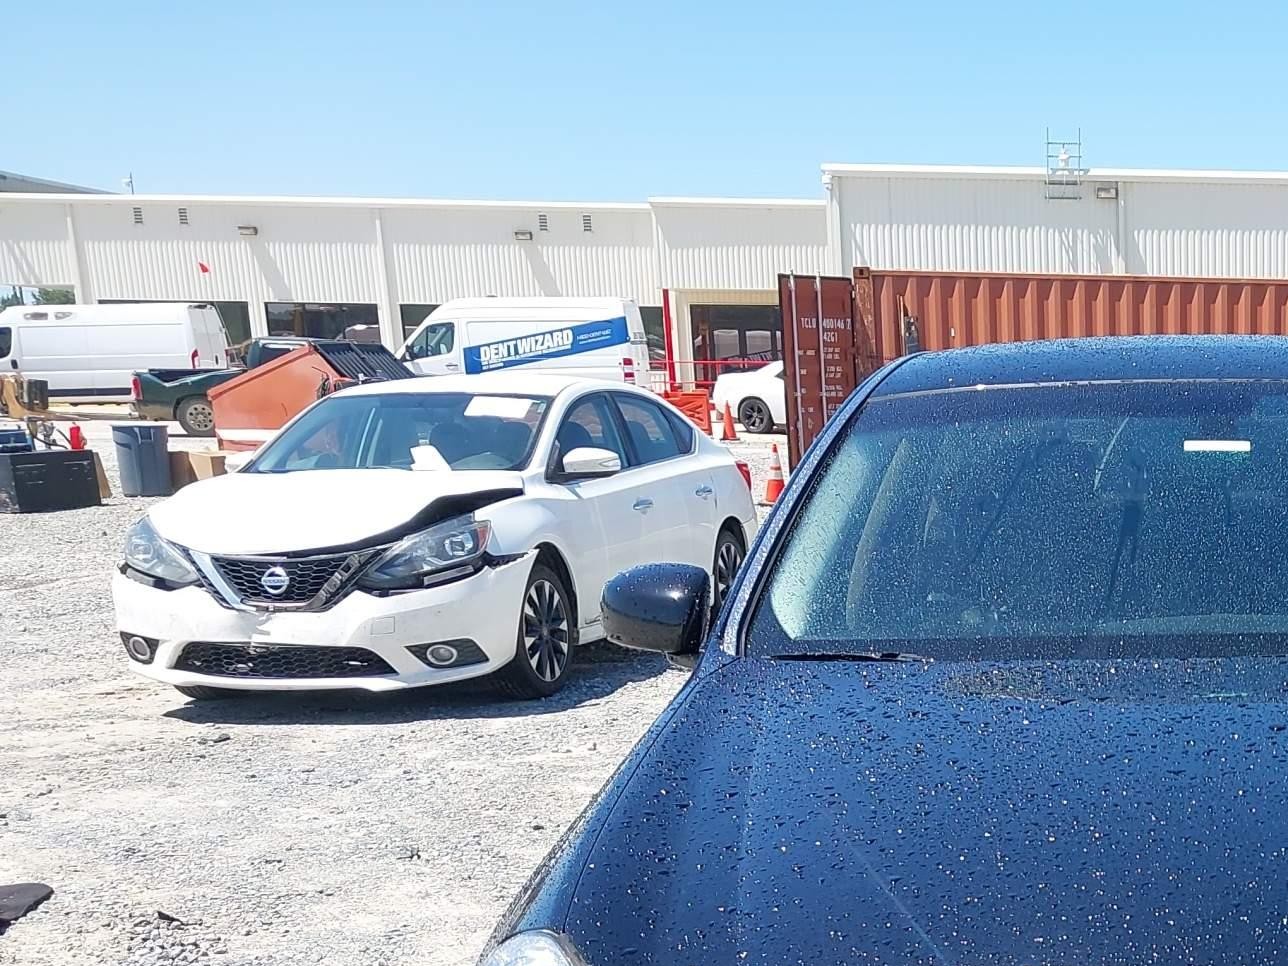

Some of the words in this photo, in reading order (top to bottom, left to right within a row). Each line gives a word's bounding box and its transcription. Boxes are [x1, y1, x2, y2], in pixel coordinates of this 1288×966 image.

[801, 318, 817, 329] TCLU
[822, 318, 845, 329] 400146
[823, 332, 838, 343] 42G1
[481, 338, 519, 361] DENT
[517, 329, 574, 355] WIZARD
